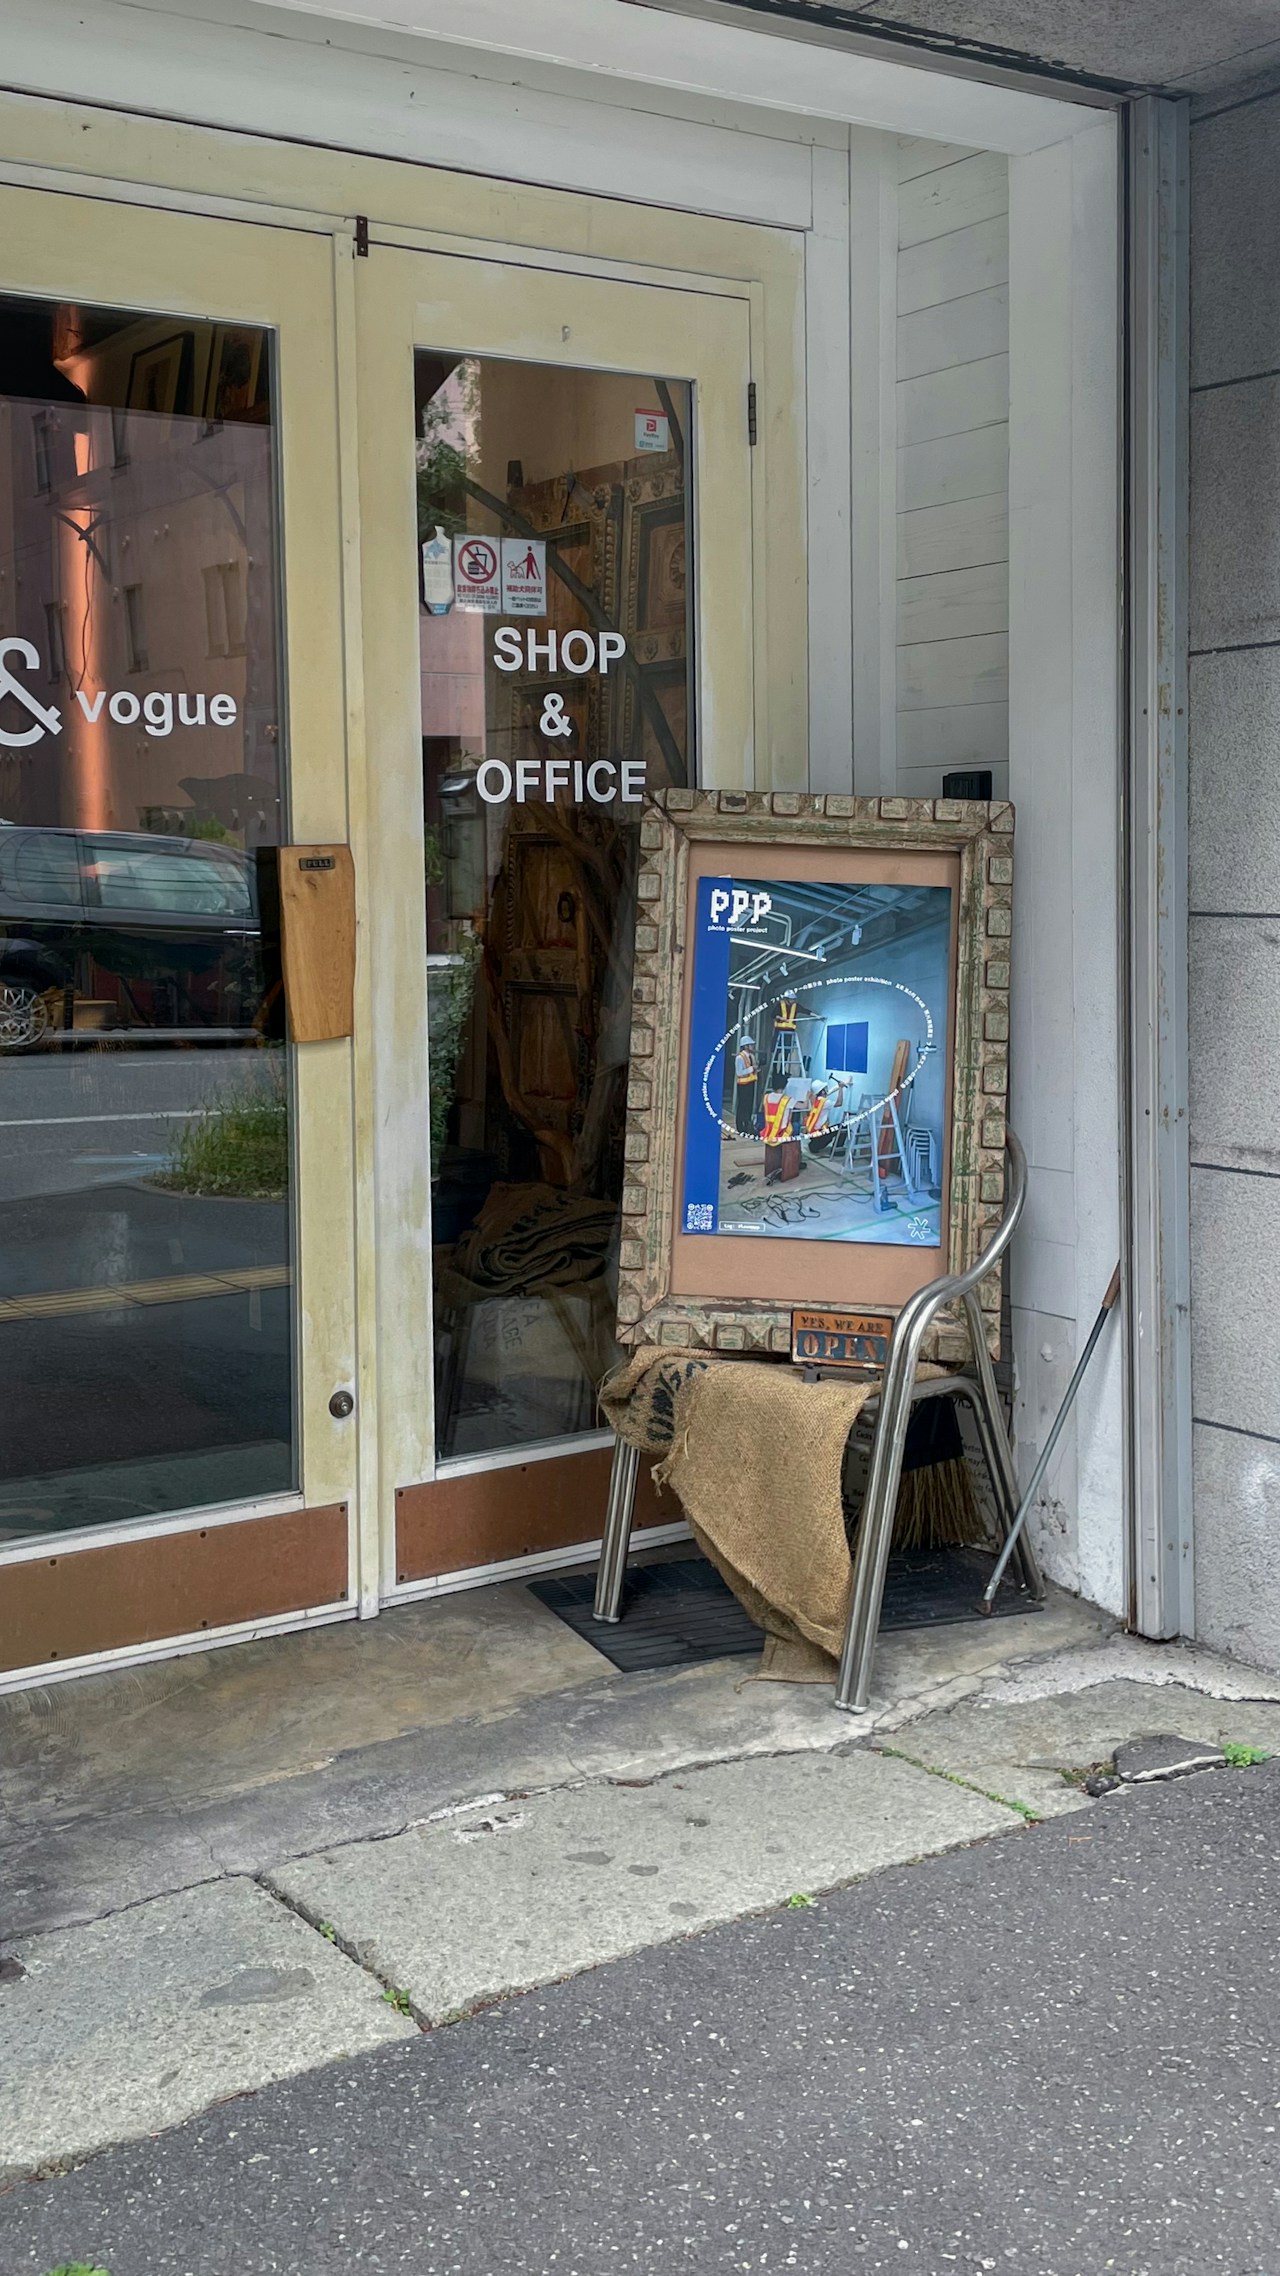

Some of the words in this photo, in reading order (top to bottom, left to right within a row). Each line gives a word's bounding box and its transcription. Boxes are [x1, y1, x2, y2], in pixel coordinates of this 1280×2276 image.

[493, 626, 627, 674] SHOP
[75, 689, 238, 737] vogue
[539, 692, 573, 737] &
[476, 758, 647, 804] OFFICE
[710, 888, 772, 924] PPP
[826, 977, 843, 986] photo
[864, 976, 892, 986] exhibition
[801, 1316, 830, 1330] YES,
[834, 1319, 855, 1331] WE
[857, 1321, 884, 1333] ARE
[803, 1332, 884, 1360] OPEN
